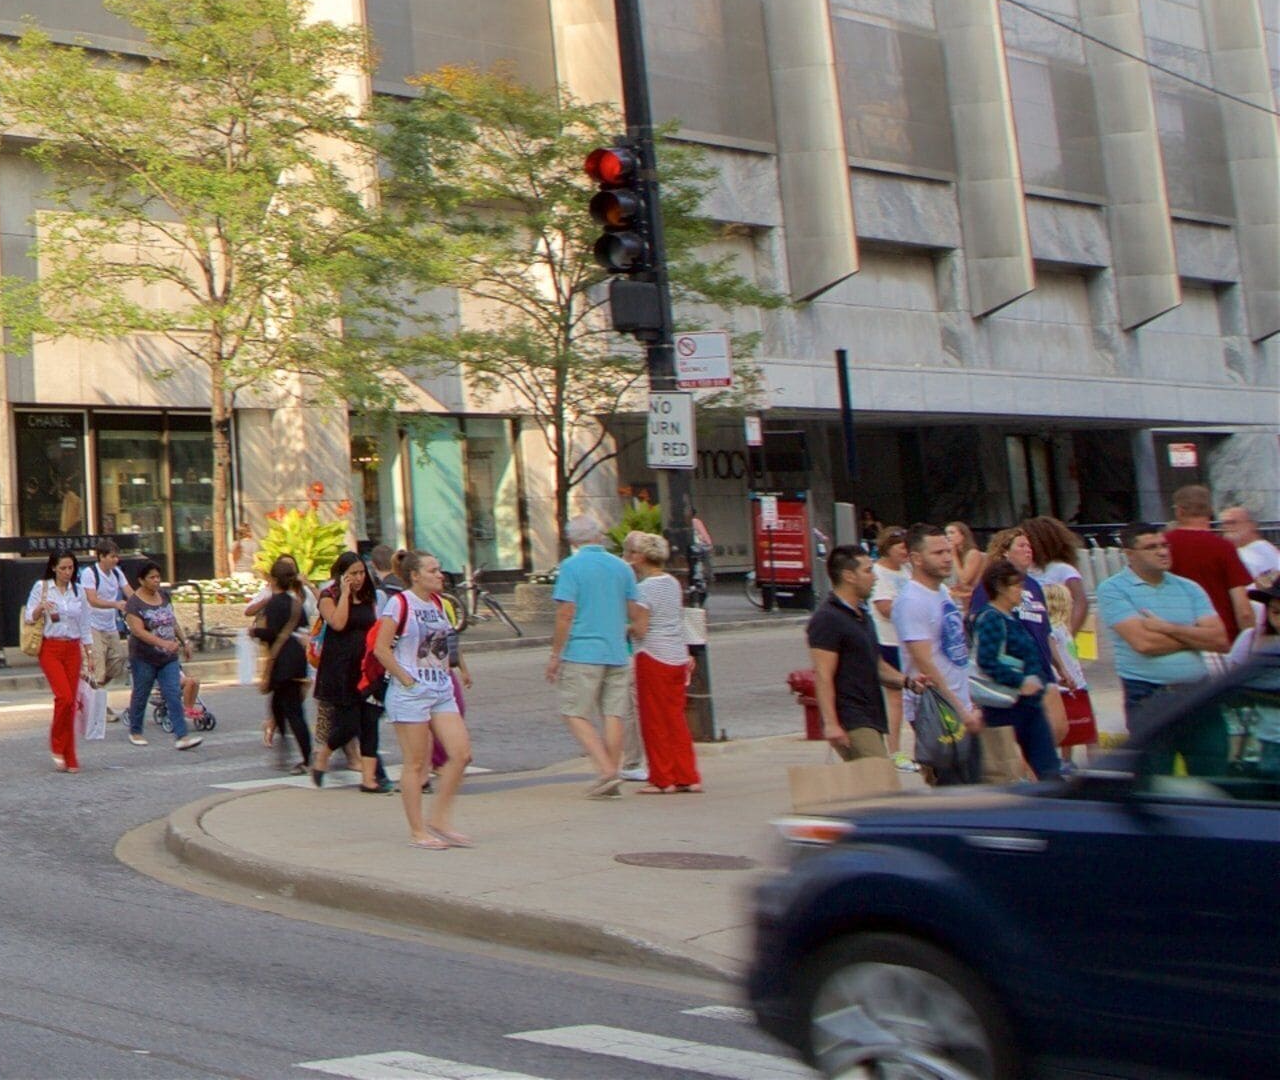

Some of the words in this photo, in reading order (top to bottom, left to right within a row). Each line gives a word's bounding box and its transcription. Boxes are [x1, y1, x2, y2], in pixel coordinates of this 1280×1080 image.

[649, 400, 672, 414] NO
[651, 421, 680, 436] URN
[661, 442, 690, 457] RED
[28, 536, 114, 551] NEWSPAPE
